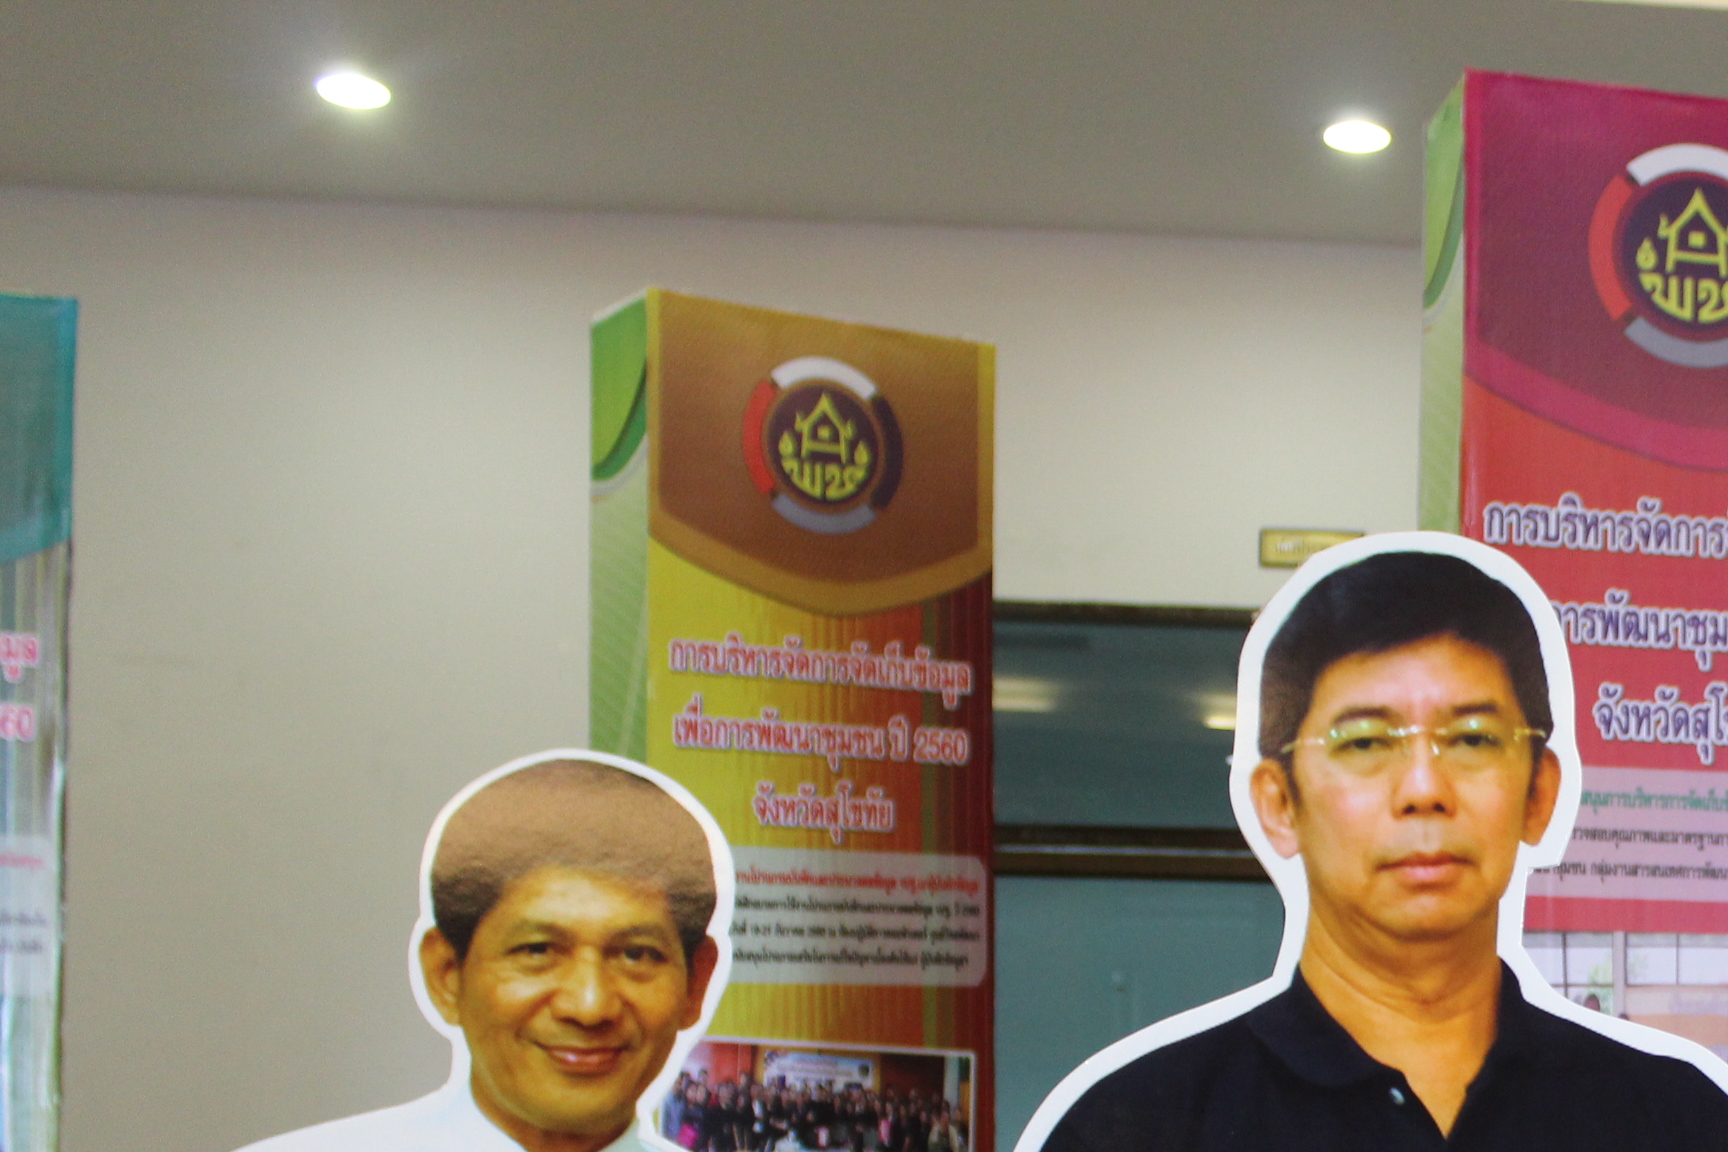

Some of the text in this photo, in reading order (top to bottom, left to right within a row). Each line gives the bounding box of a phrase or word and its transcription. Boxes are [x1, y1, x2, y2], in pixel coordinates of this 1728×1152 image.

[669, 632, 971, 708] การบริหารจัดการจัดเก็บข้อมูล
[673, 694, 967, 770] เพื่อการพัฒนาชุมชน ปี 2560
[752, 781, 894, 842] จังหวัดสุโขทัย
